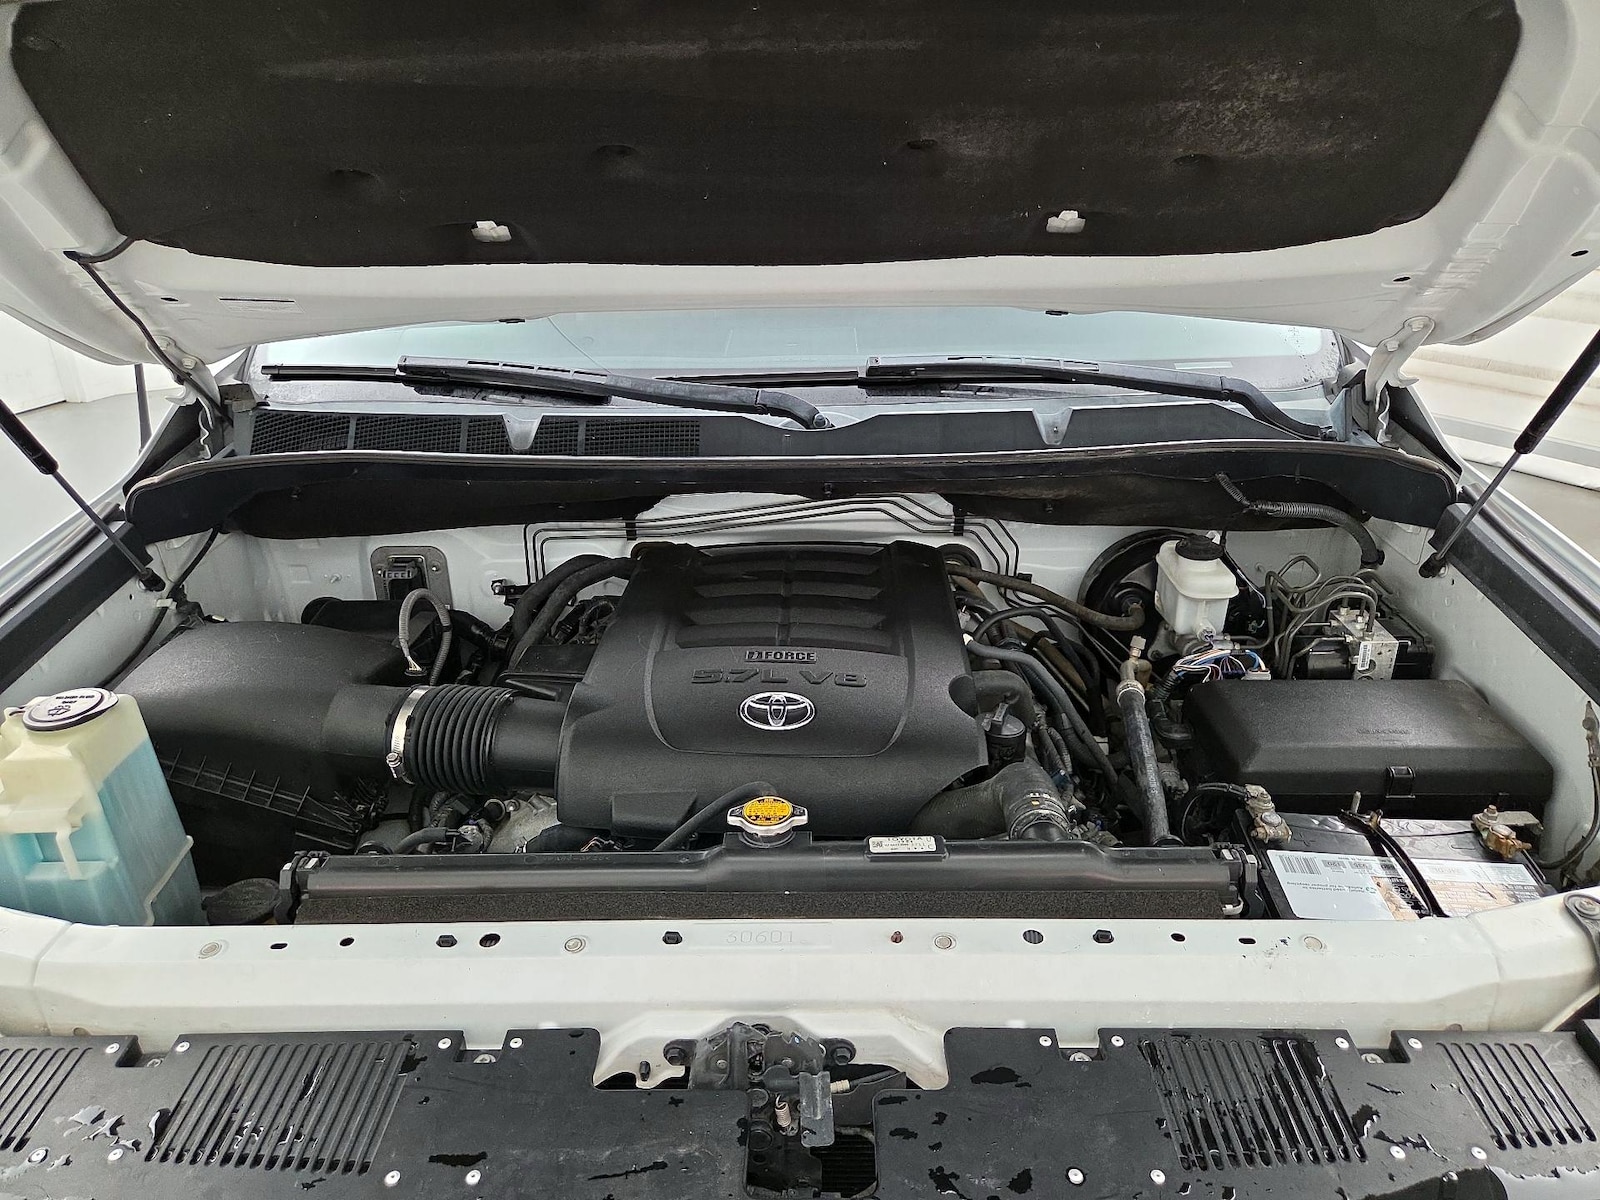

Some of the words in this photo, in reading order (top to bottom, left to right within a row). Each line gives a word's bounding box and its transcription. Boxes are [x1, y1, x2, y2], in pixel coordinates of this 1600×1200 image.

[692, 668, 789, 684] 5.7L
[799, 669, 867, 687] V8
[726, 930, 794, 944] 30601
